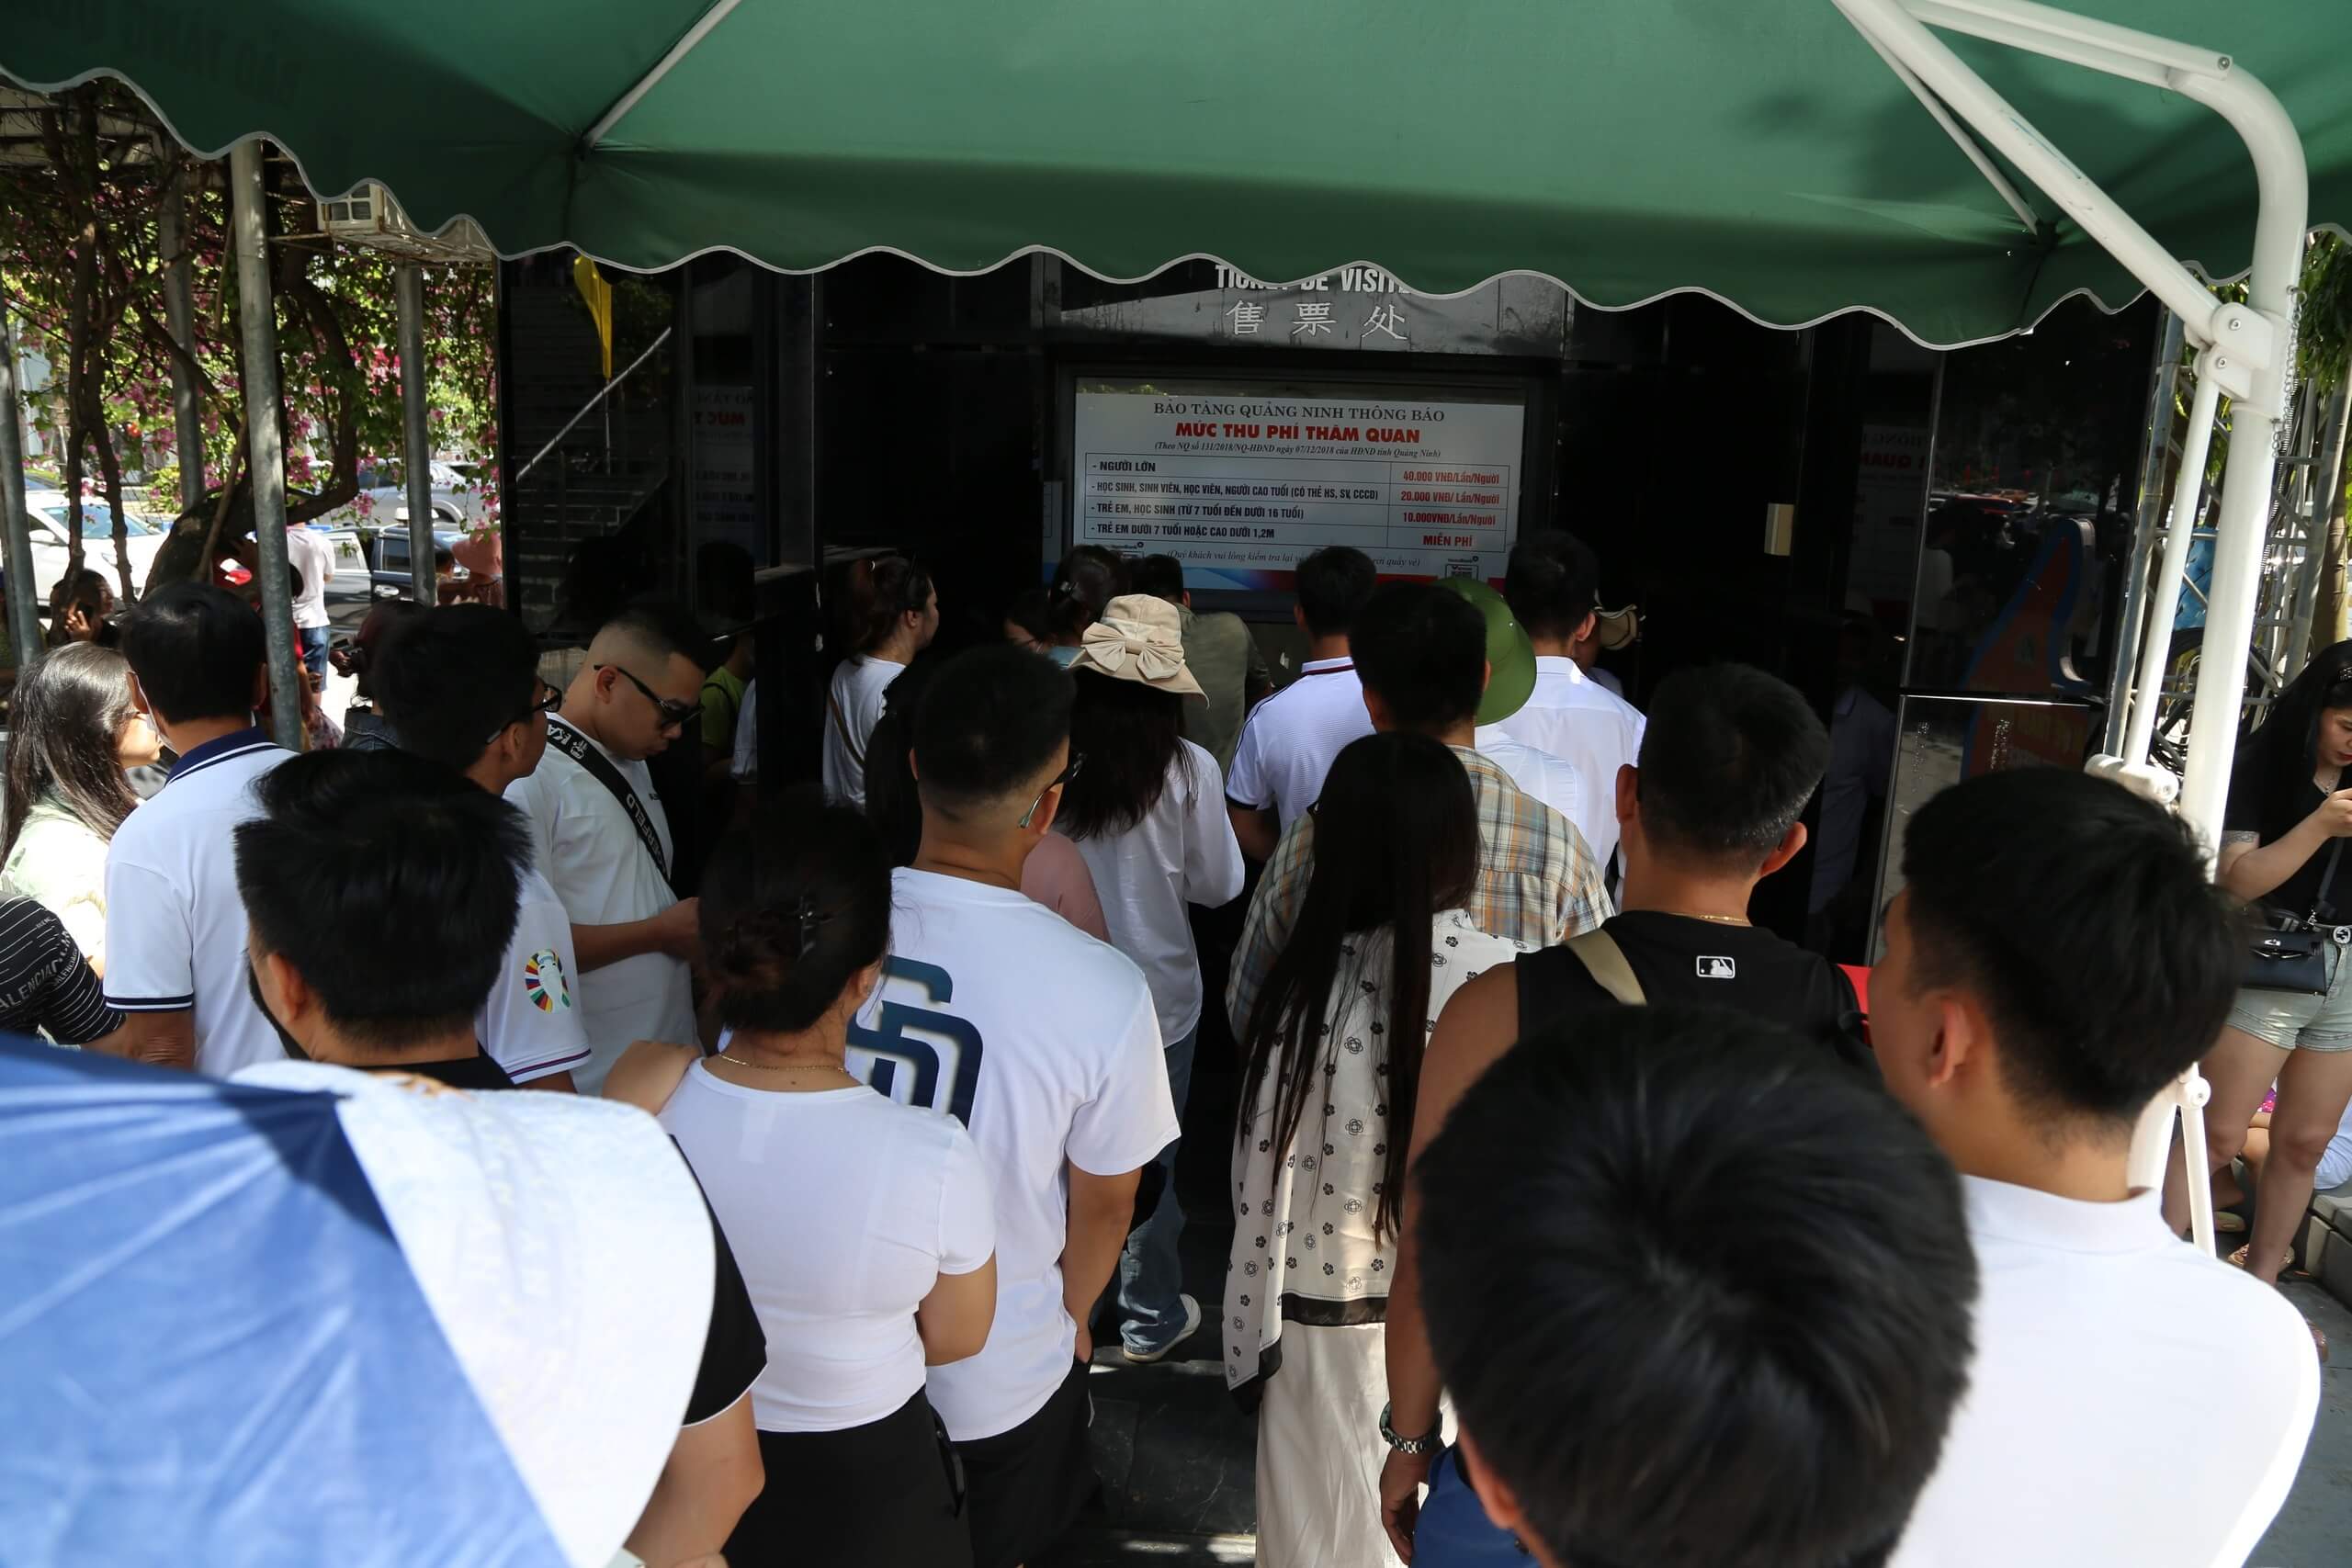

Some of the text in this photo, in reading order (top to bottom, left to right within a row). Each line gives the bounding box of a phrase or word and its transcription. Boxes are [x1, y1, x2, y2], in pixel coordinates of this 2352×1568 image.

[1215, 265, 1288, 290] TIC
[1340, 267, 1412, 294] VISIT
[1226, 299, 1408, 341] 售票处
[1191, 400, 1235, 415] TÀNG
[1302, 406, 1343, 419] NINH
[1349, 404, 1406, 421] THÔNG
[1411, 406, 1444, 422] BÁO
[1223, 423, 1260, 438] THU
[1266, 422, 1299, 440] PHÍ
[1365, 427, 1420, 444] QUAN
[1154, 441, 1176, 451] (Theo
[1295, 445, 1335, 456] 07/12/2018
[1403, 470, 1433, 482] 40.000
[1097, 481, 1114, 493] HỌC
[1139, 482, 1159, 493] SINH
[1183, 483, 1200, 496] HỌC
[1252, 486, 1269, 496] CAO
[1401, 491, 1430, 502] 20.000
[1134, 504, 1152, 516] HỌC
[1154, 504, 1175, 515] SINH
[1268, 508, 1278, 518] 16
[1115, 525, 1129, 534] EM
[1209, 526, 1227, 537] CAO
[1253, 528, 1274, 539] 1,2M
[1454, 535, 1474, 547] PHÍ
